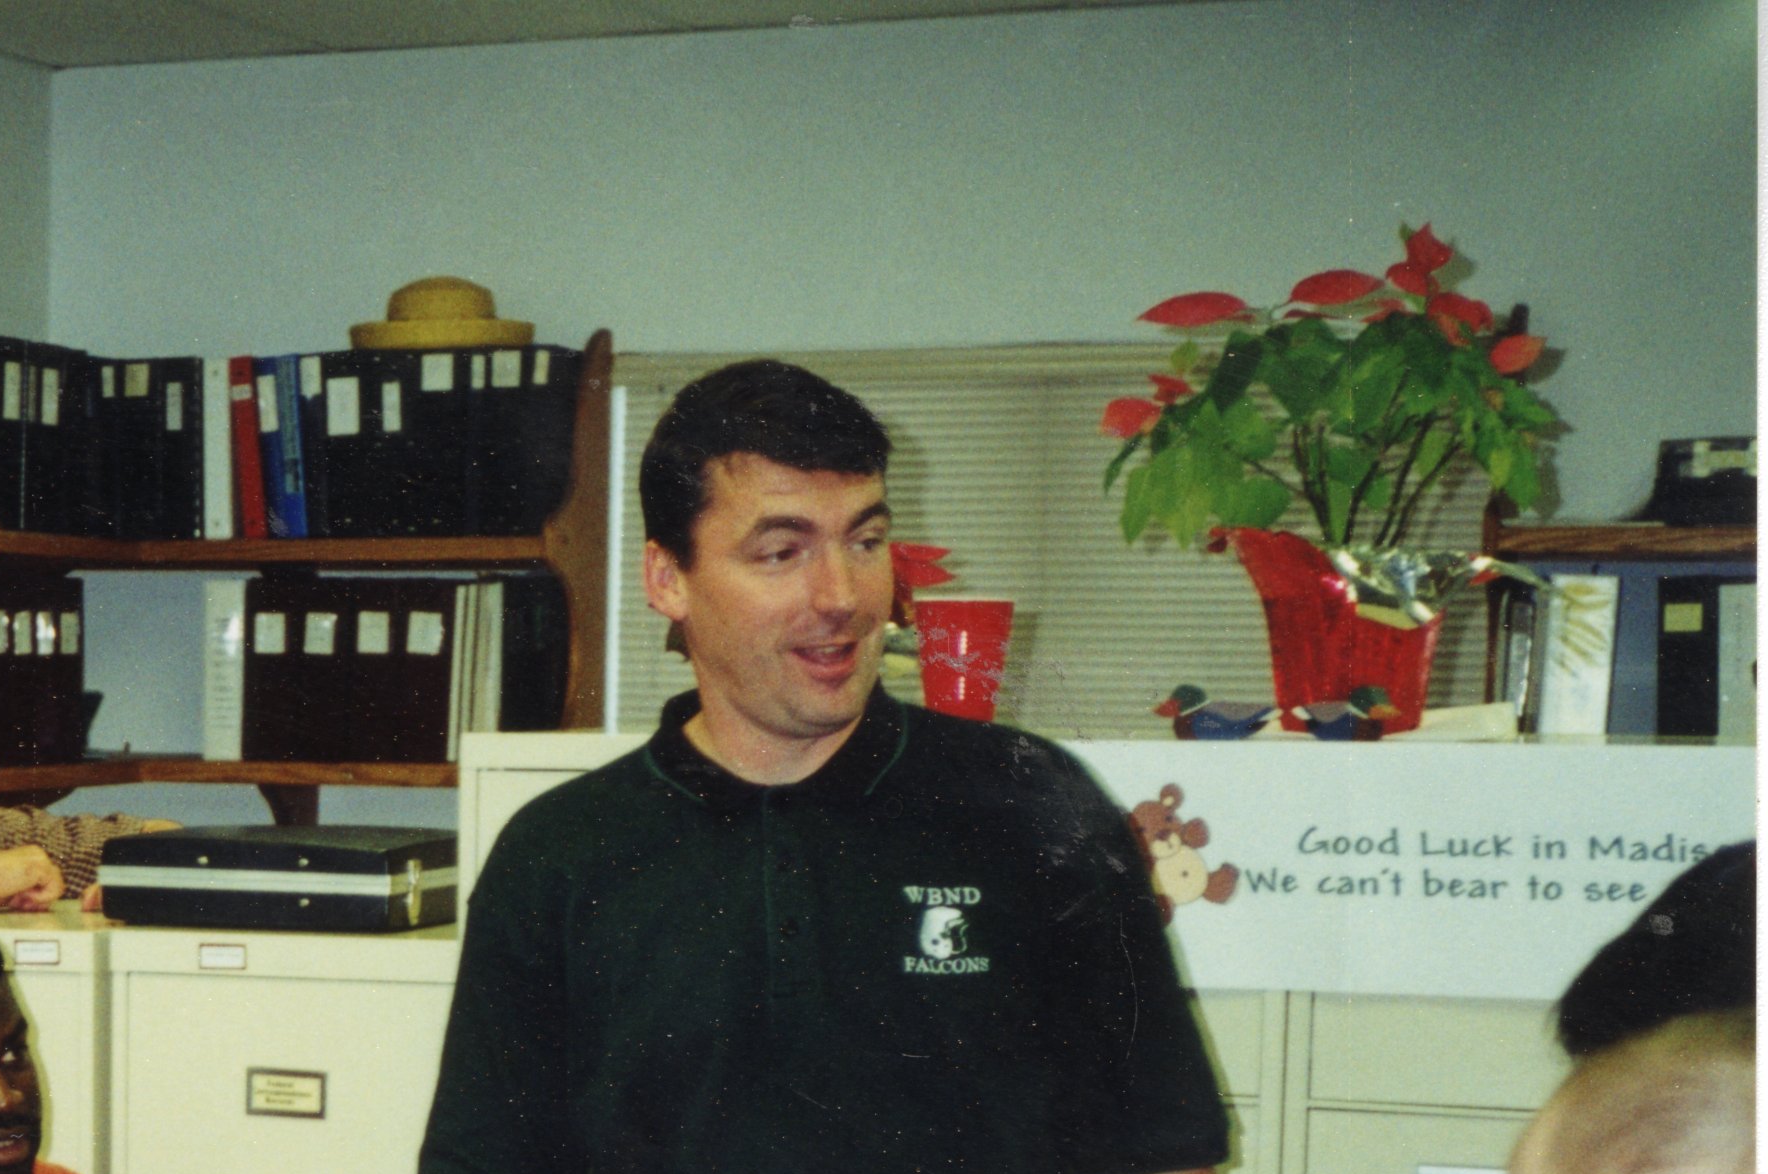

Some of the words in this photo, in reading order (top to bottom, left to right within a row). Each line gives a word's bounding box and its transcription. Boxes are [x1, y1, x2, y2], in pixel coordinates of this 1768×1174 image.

[1297, 827, 1401, 856] Good
[1420, 831, 1513, 857] Luck
[1532, 835, 1566, 860] in
[903, 886, 982, 905] WBND
[1244, 867, 1299, 893] We
[1317, 868, 1402, 896] can't
[1423, 868, 1508, 899] bear
[1528, 875, 1563, 900] to
[1584, 882, 1648, 901] see
[903, 956, 991, 974] FALCONS
